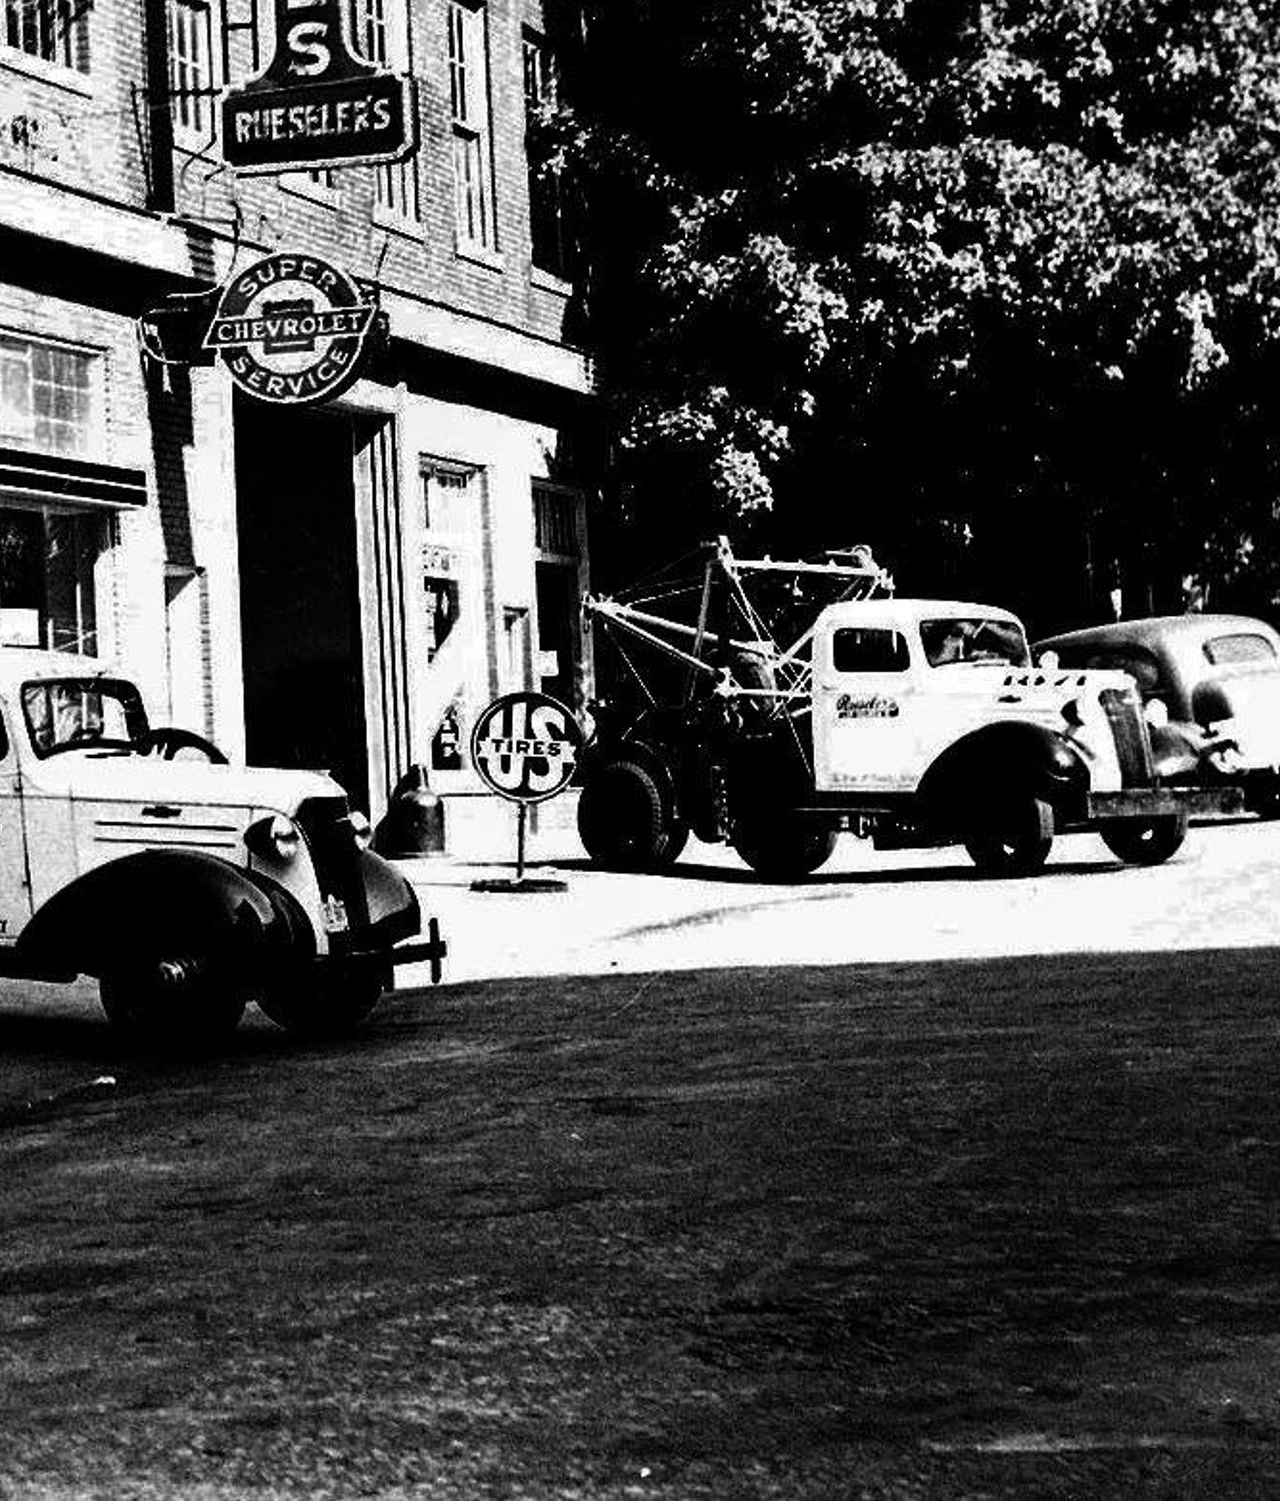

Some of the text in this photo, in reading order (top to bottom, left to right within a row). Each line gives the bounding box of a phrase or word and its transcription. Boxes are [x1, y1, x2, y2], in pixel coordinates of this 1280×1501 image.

[234, 94, 391, 143] RUESELER'S
[238, 258, 338, 298] SUPER
[217, 312, 362, 342] CHEVROLET
[231, 347, 349, 396] SERVICE
[490, 737, 562, 757] TIRES
